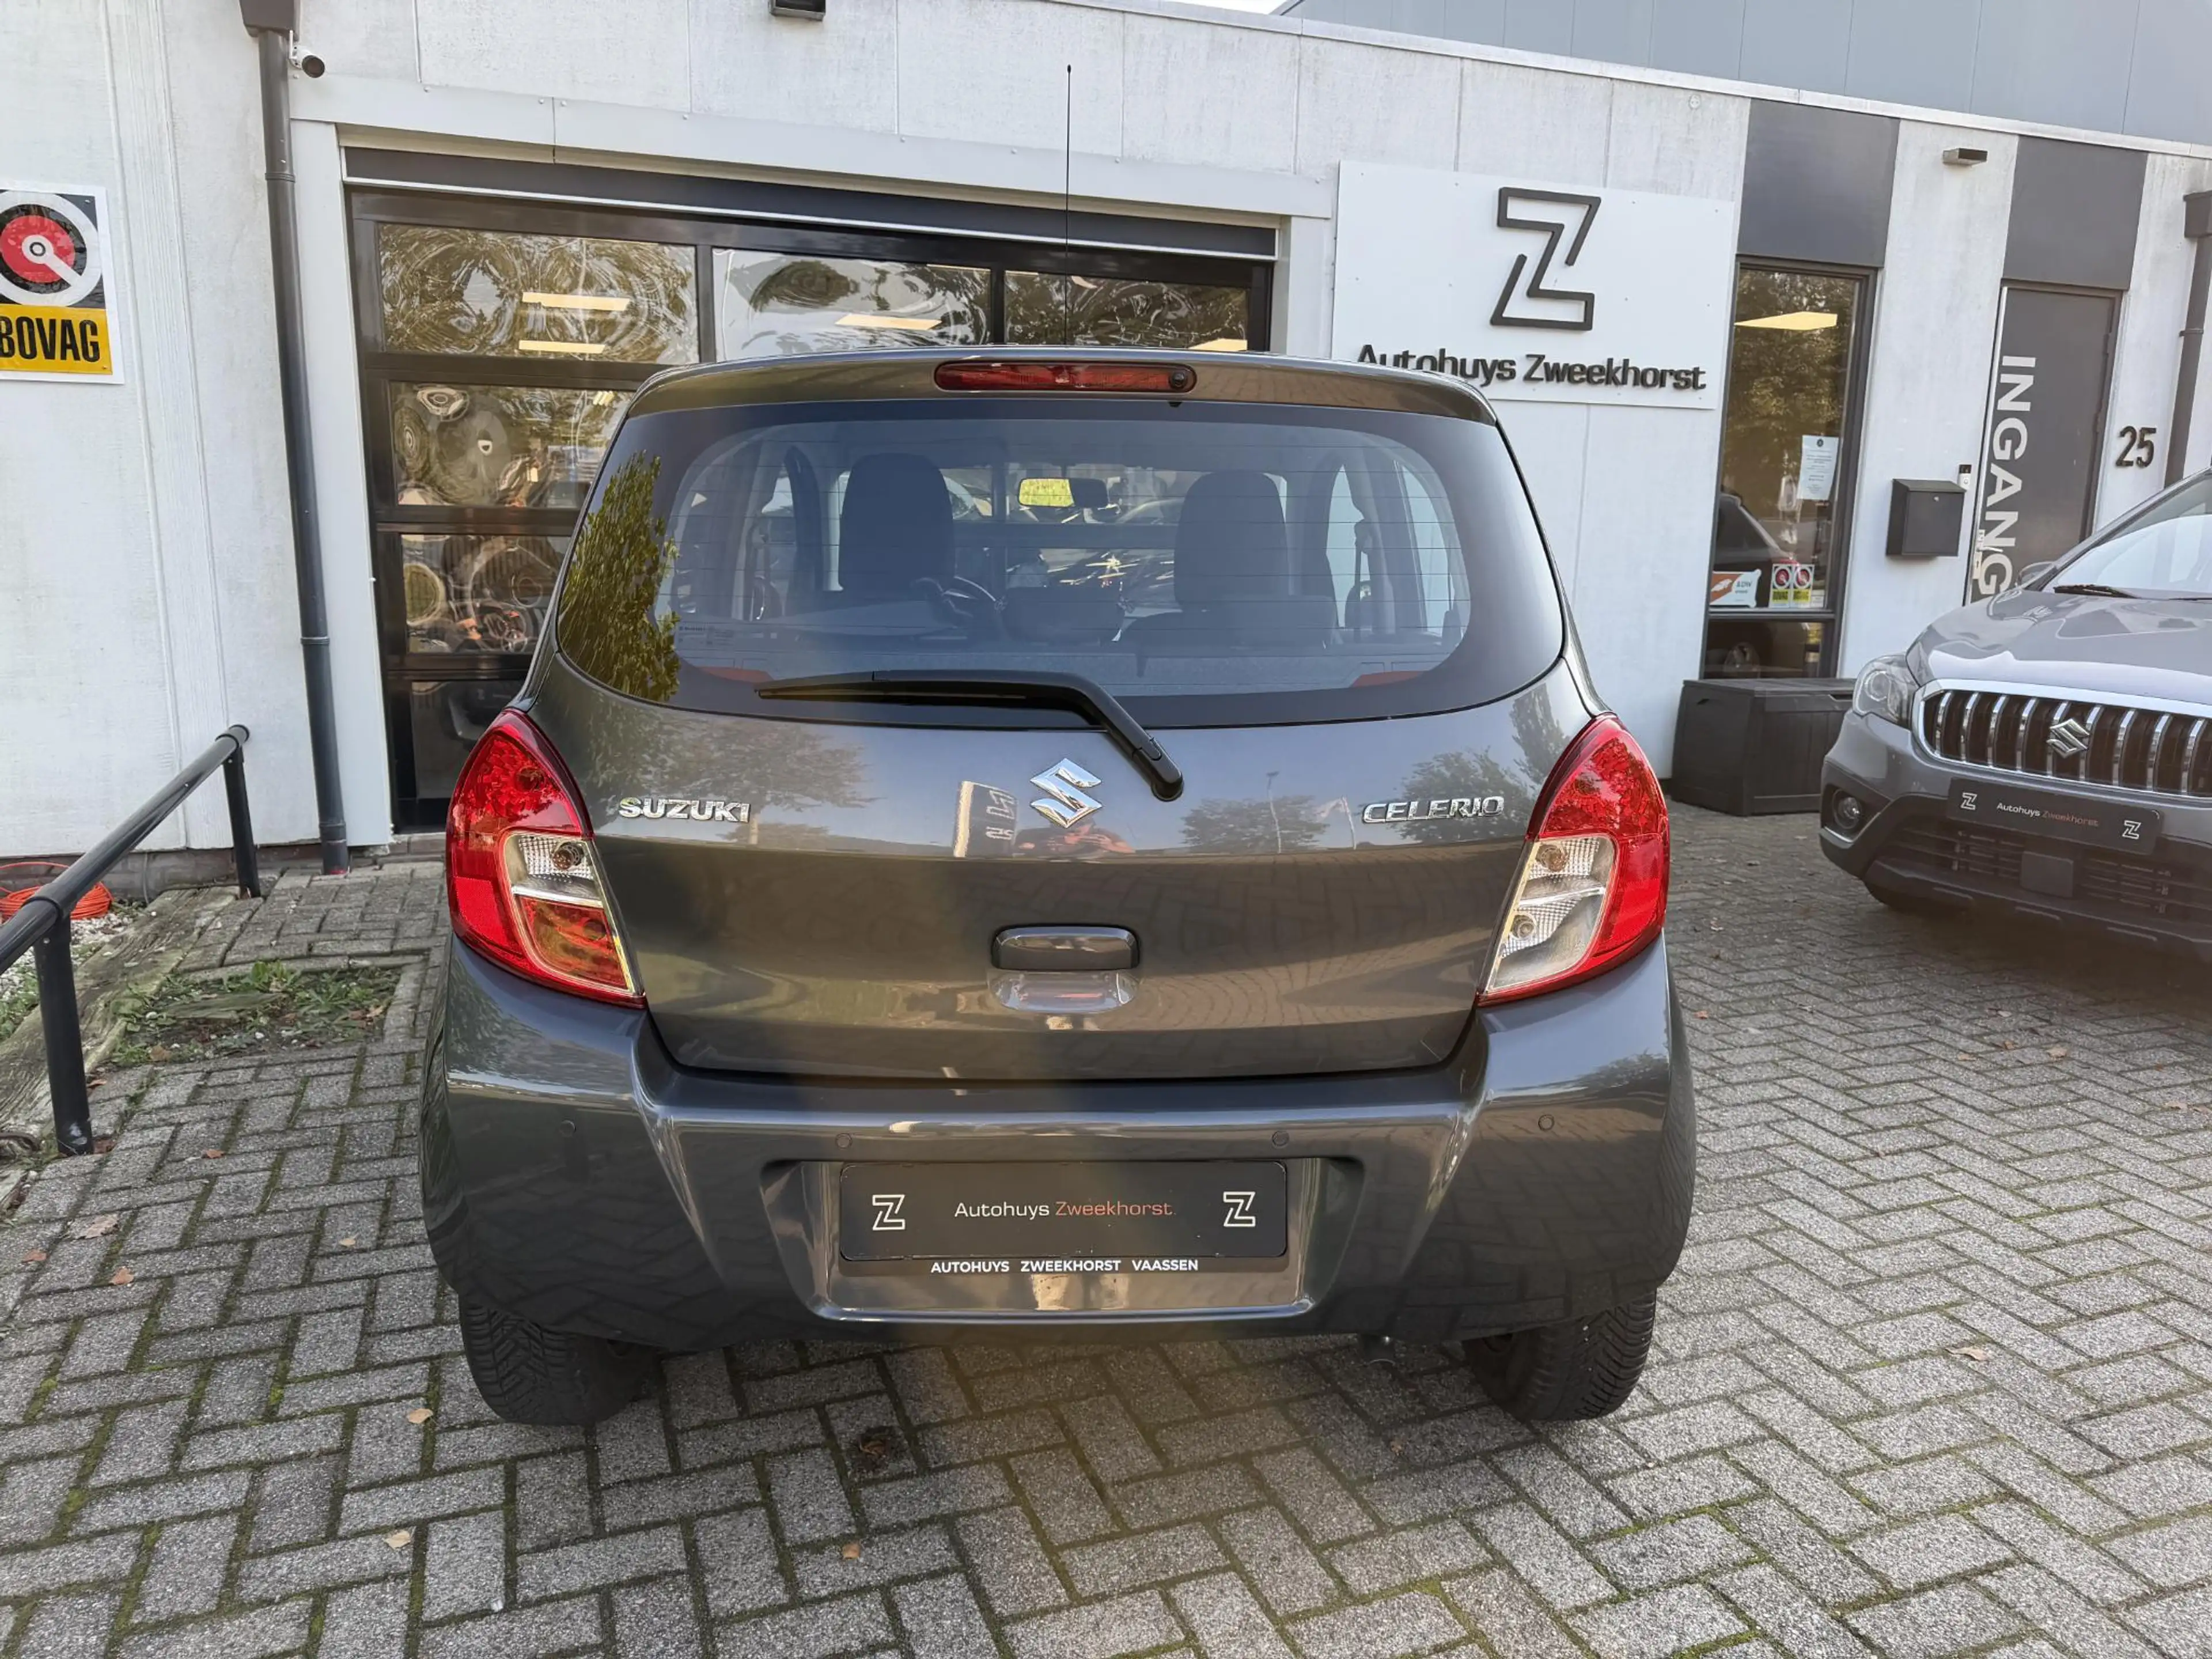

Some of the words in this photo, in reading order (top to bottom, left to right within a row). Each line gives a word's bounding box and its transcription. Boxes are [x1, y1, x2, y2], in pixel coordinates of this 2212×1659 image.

[0, 316, 100, 362] BOVAG
[1357, 344, 1517, 387] Autohuys
[1522, 354, 1707, 390] Zweekhorst
[2115, 425, 2157, 468] 25
[1978, 355, 2036, 595] INGANG
[618, 797, 751, 823] SUZUKI
[1362, 796, 1505, 824] CELERIO
[1997, 802, 2040, 817] Autohuys
[954, 1201, 1050, 1220] Autohuys
[930, 1260, 1010, 1274] AUTOHUYS
[1020, 1259, 1122, 1272] ZWEEKHORST
[1131, 1259, 1199, 1272] VAASSEN
